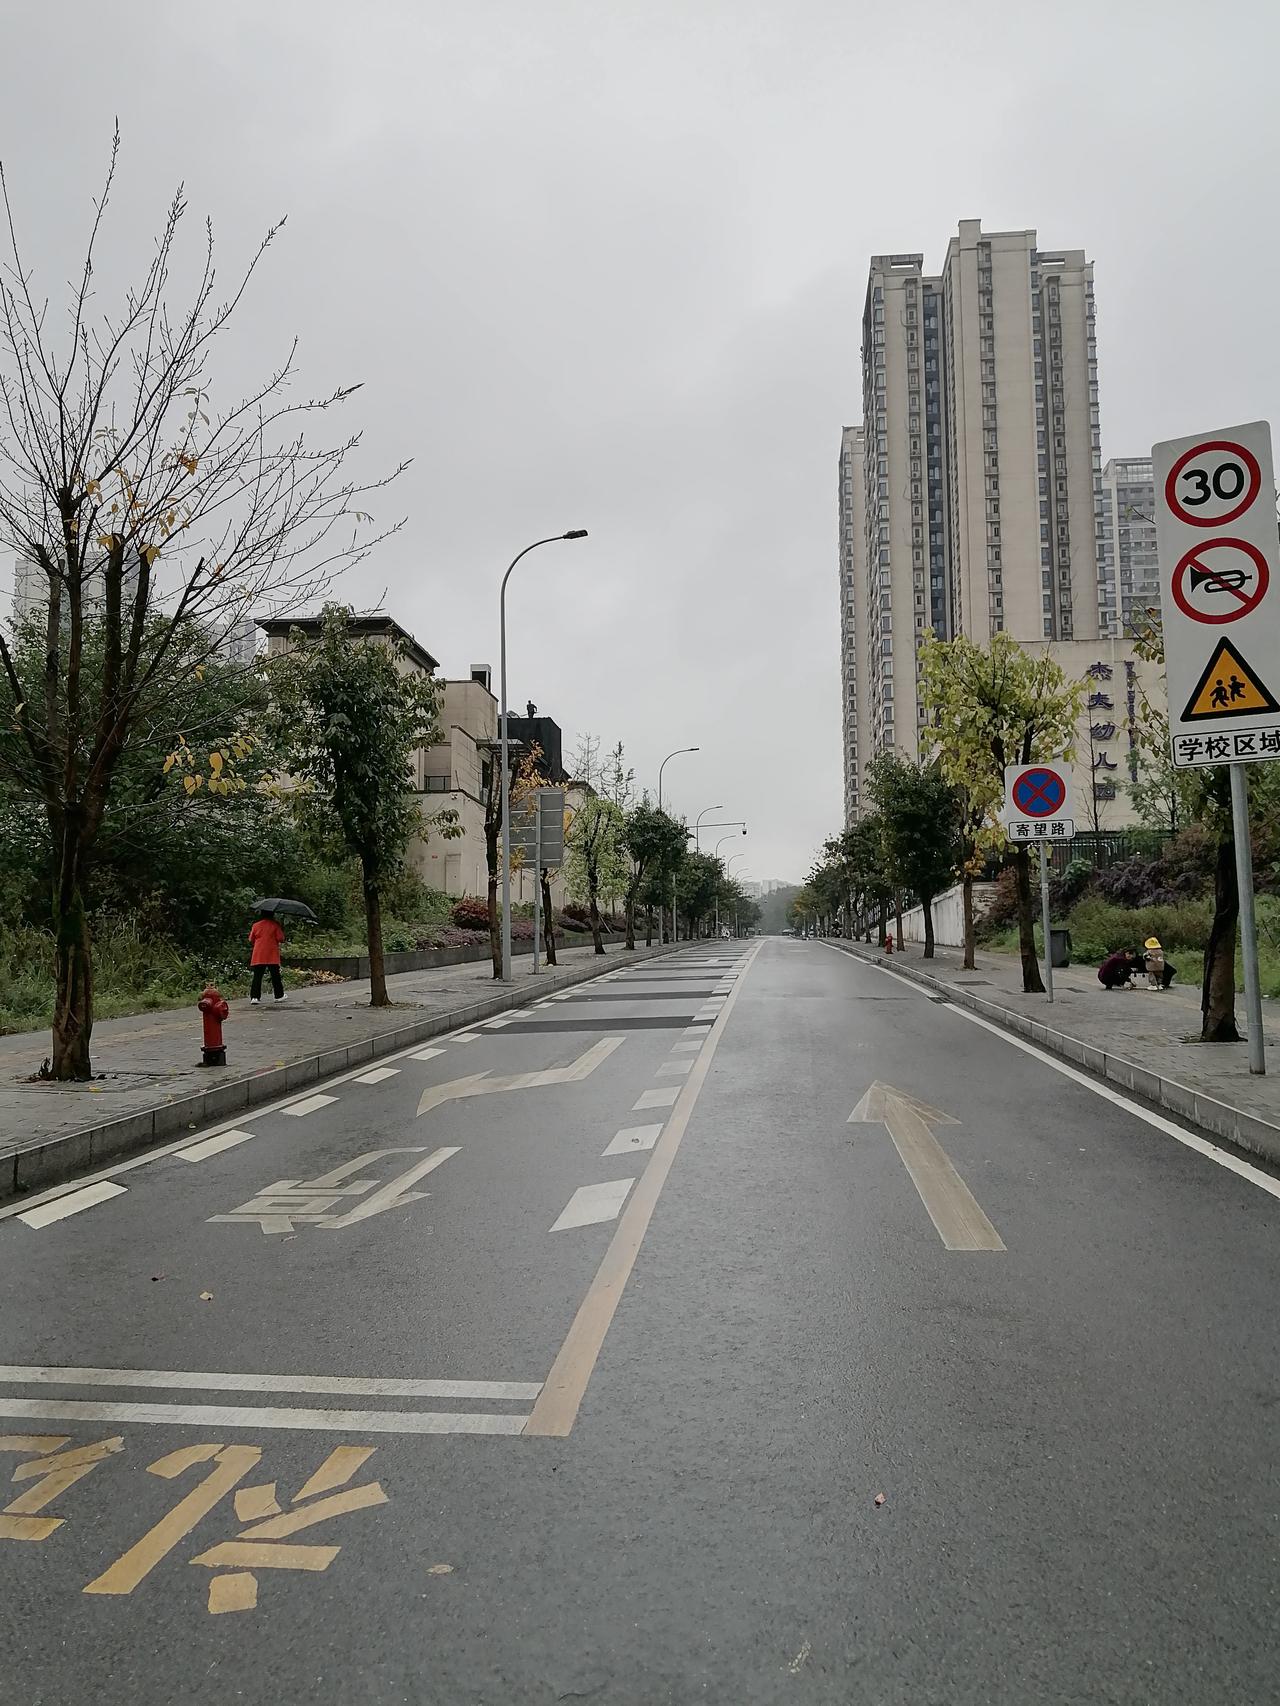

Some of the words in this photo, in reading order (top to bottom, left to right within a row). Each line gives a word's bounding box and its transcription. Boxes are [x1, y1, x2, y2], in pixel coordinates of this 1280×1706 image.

[1181, 463, 1245, 506] 30
[1178, 730, 1280, 761] 学校区域
[1016, 822, 1065, 836] 寄望路
[204, 1147, 463, 1235] 停
